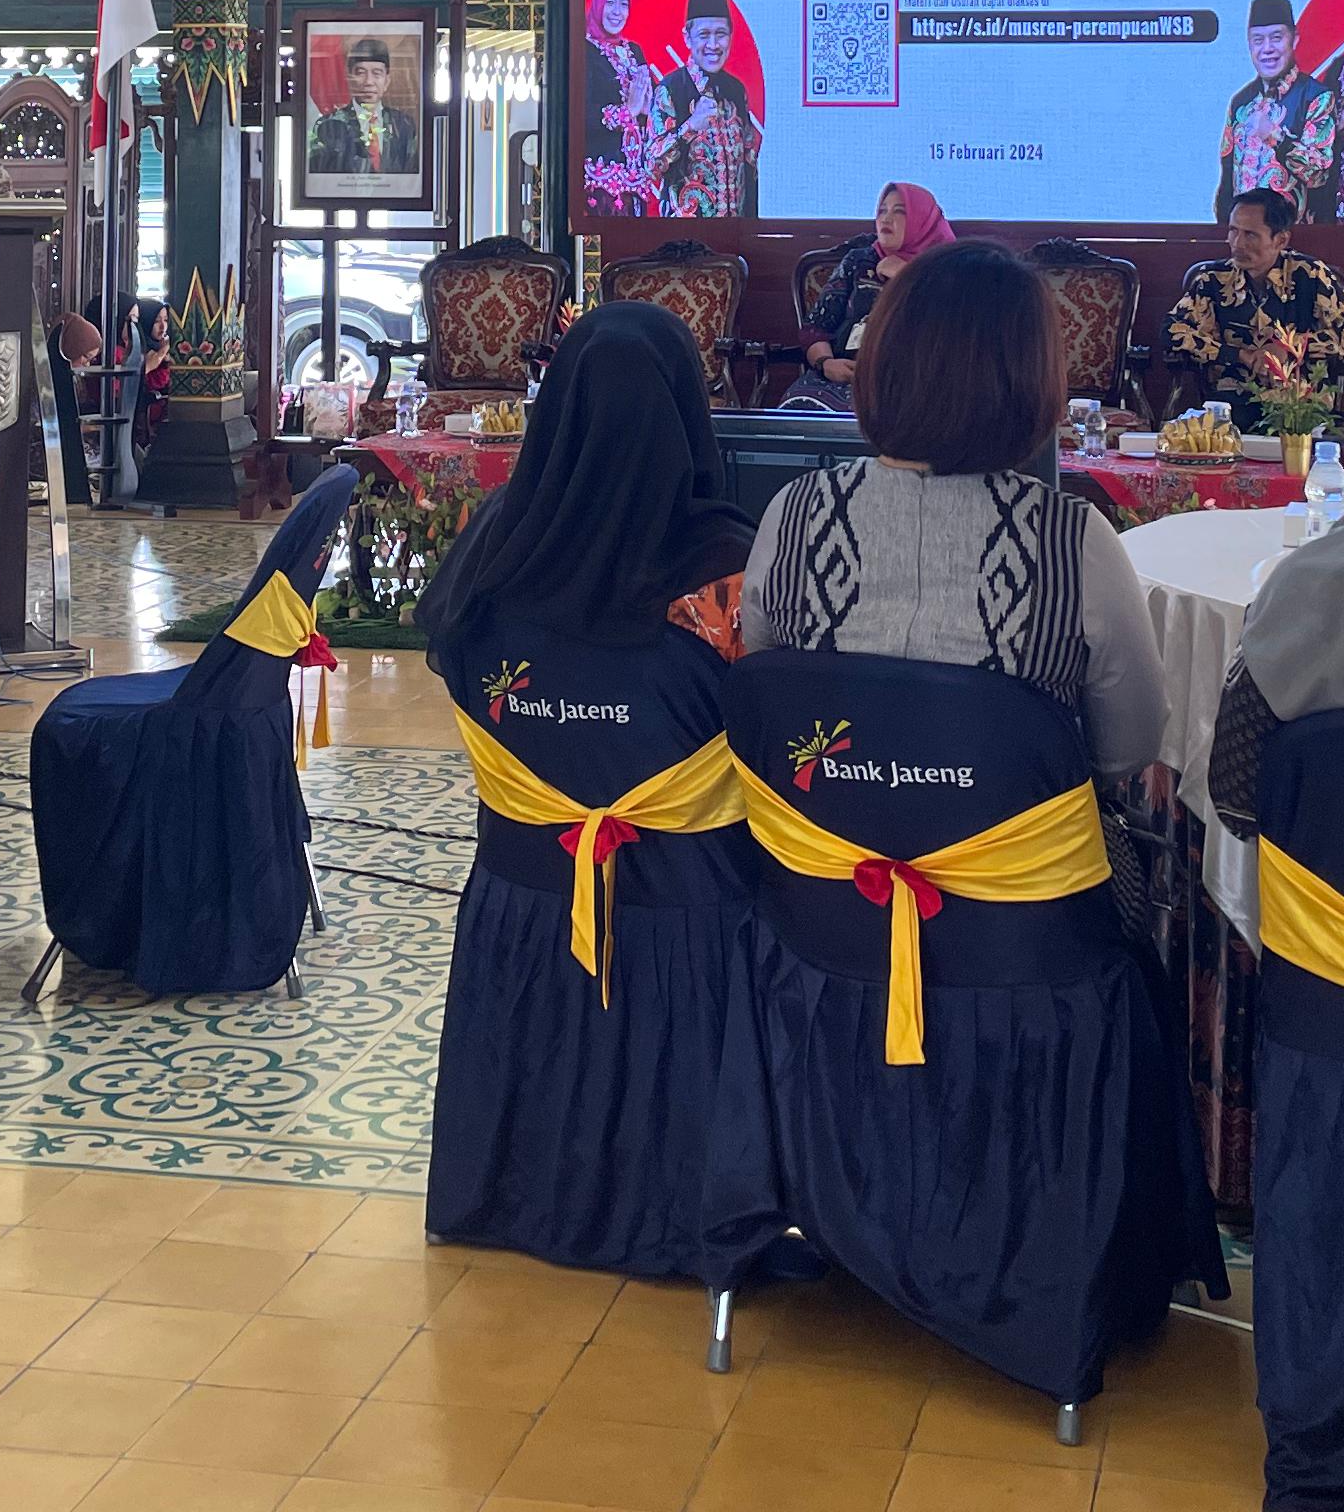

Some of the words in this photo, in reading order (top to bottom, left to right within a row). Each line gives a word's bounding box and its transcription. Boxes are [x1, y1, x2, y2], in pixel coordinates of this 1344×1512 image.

[912, 16, 1194, 40] https://s.id/musren-perempuanWSB
[929, 143, 944, 160] 15
[949, 143, 1005, 160] Februari
[1010, 142, 1043, 160] 2024
[507, 693, 555, 718] Bank
[558, 699, 630, 724] Jateng
[822, 757, 884, 782] Bank
[890, 761, 974, 788] Jateng
